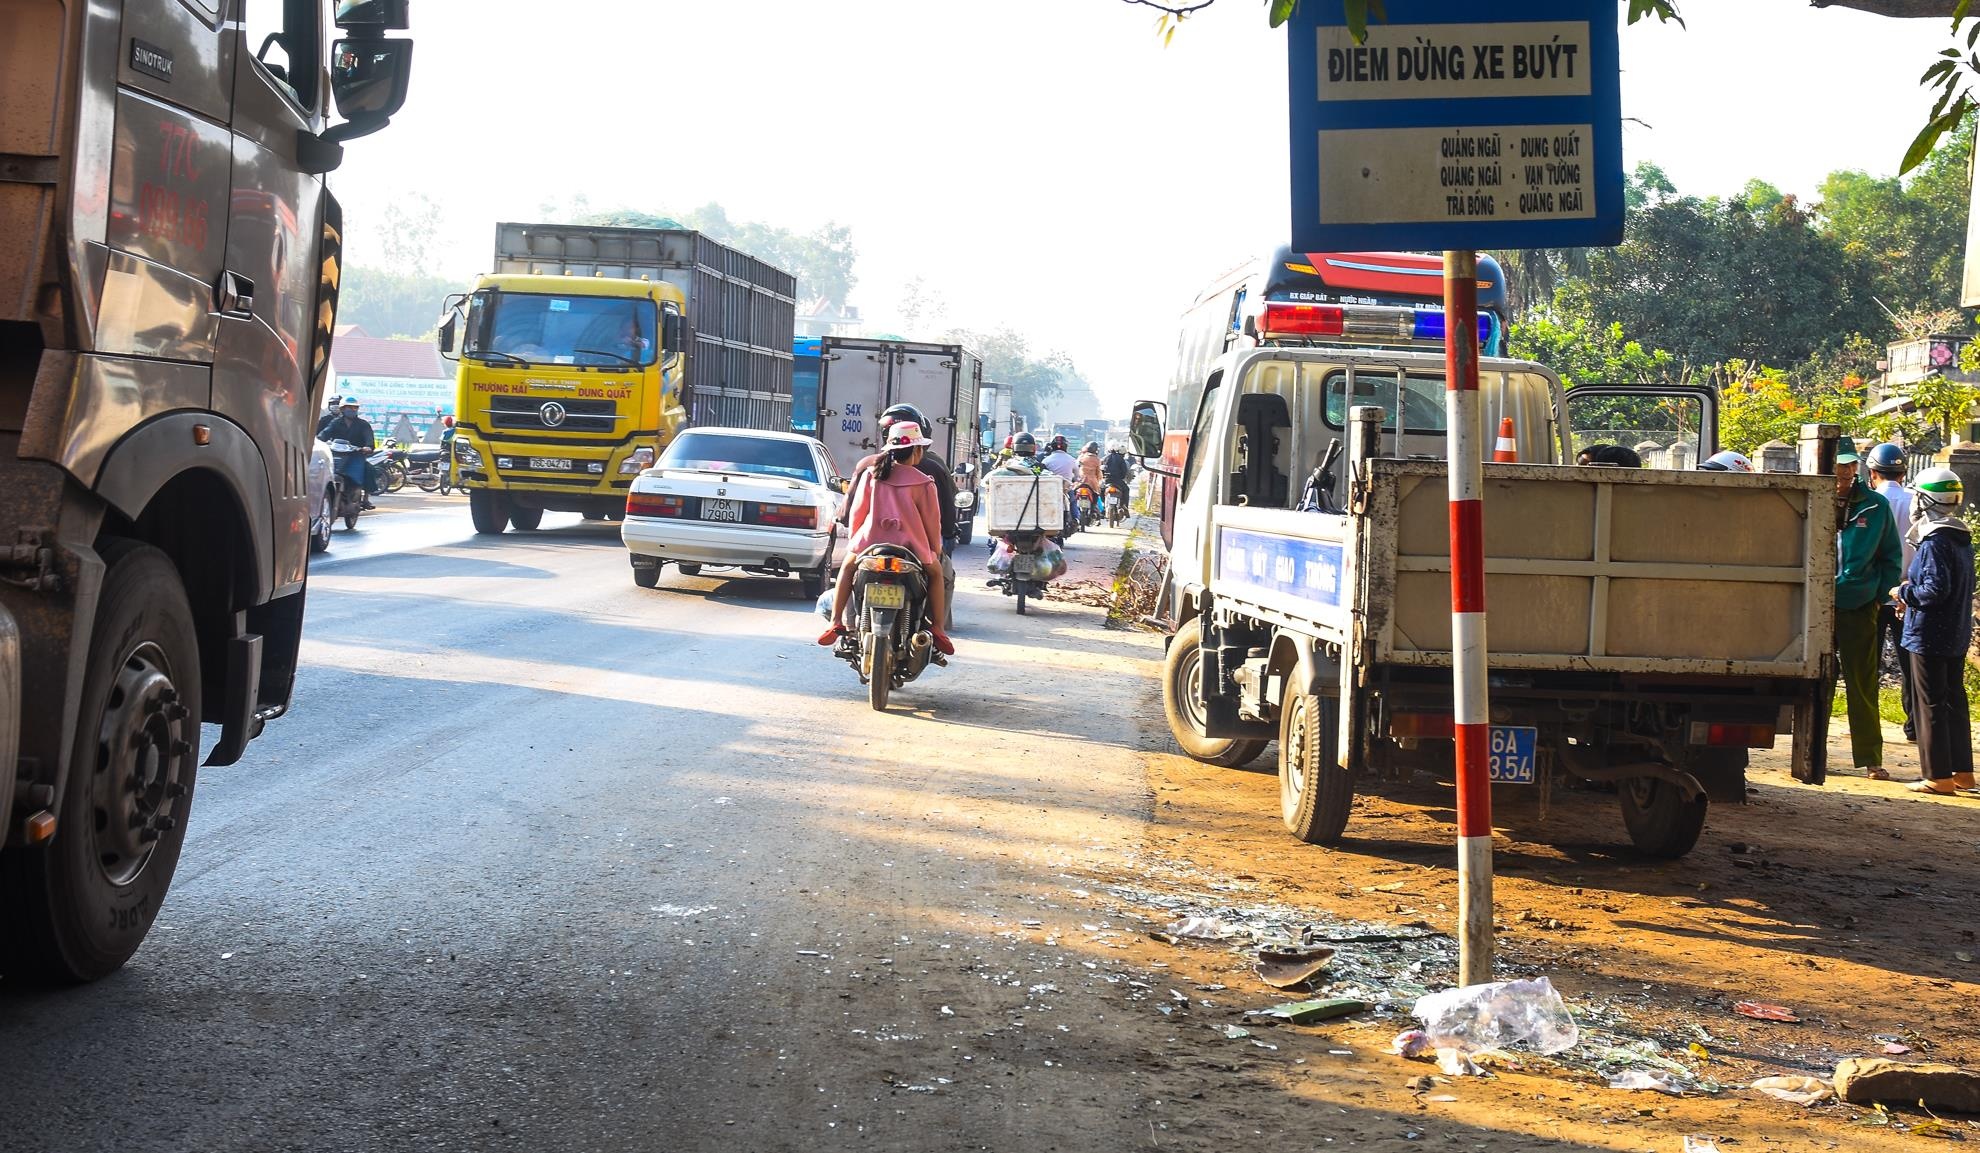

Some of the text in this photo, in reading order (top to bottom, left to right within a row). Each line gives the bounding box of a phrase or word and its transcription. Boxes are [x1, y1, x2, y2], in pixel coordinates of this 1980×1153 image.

[134, 47, 173, 74] SINOTRUK
[1397, 36, 1465, 81] DỪNG
[1472, 45, 1505, 80] XE
[1513, 35, 1578, 80] BUÝT
[160, 121, 204, 183] 77C
[1441, 129, 1580, 158] QUẢNG NGÃI DUNG QUẤT
[1440, 159, 1475, 187] QUẢNG
[1519, 186, 1553, 214] QUẢNG
[1559, 188, 1583, 212] NGÃI
[578, 387, 604, 398] DUNG
[845, 404, 862, 416] 54X
[841, 420, 862, 433] 8400
[711, 500, 732, 510] 76K
[1275, 554, 1295, 584] GIAO
[1305, 553, 1336, 593] THÔNG
[1491, 730, 1517, 753] 6A
[1489, 756, 1532, 780] 3.54
